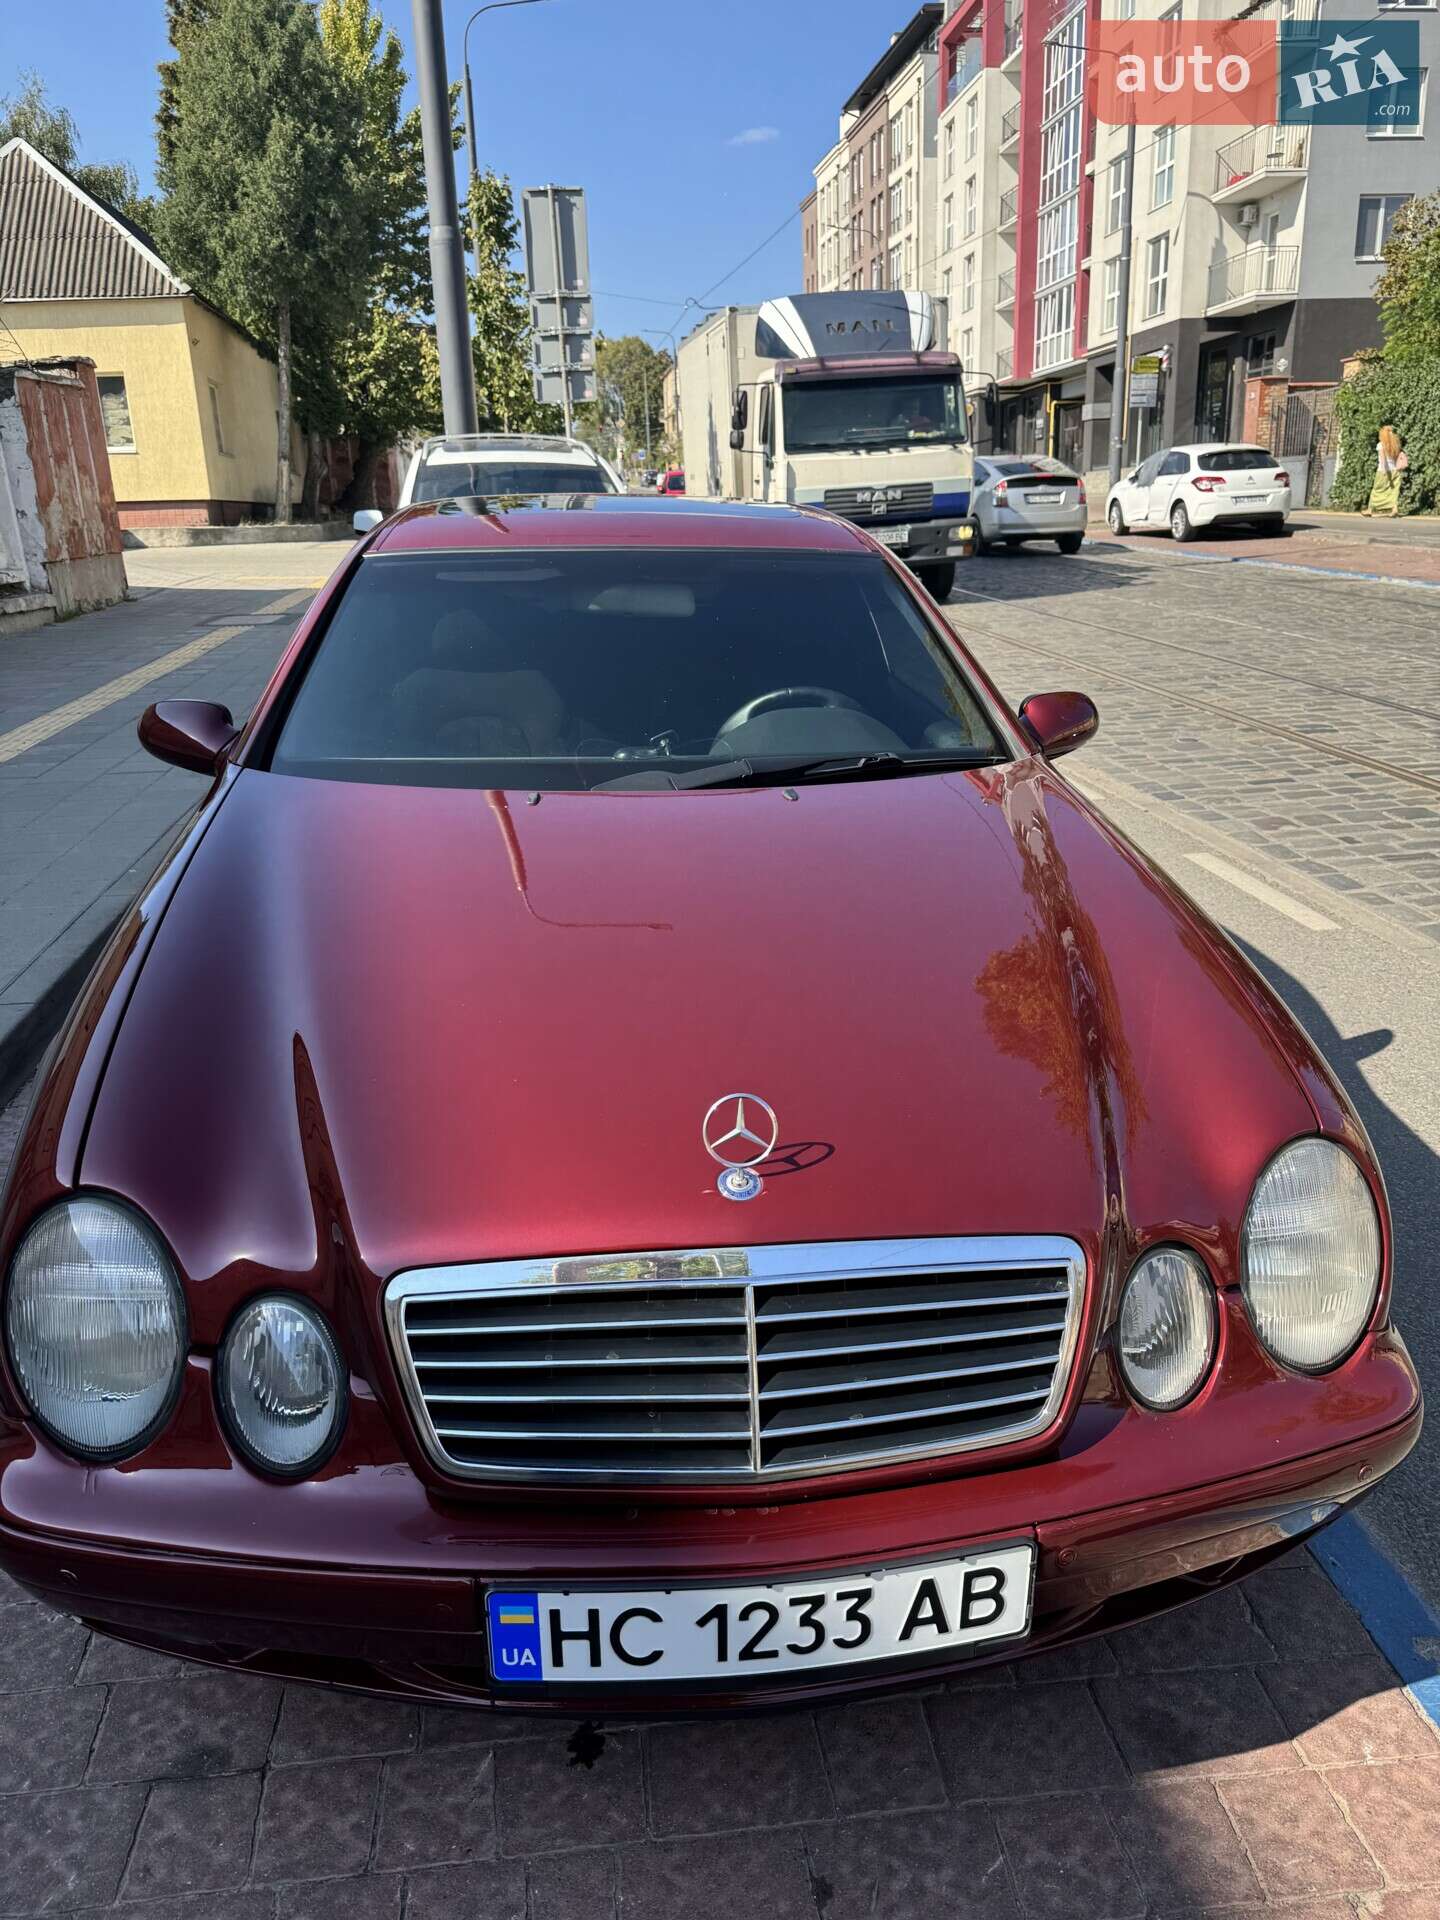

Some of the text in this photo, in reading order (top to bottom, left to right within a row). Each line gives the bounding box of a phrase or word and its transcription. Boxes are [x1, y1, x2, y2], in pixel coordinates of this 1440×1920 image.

[856, 489, 902, 503] MAN
[549, 1567, 1007, 1668] HC 1233 AB
[502, 1648, 537, 1666] UA
